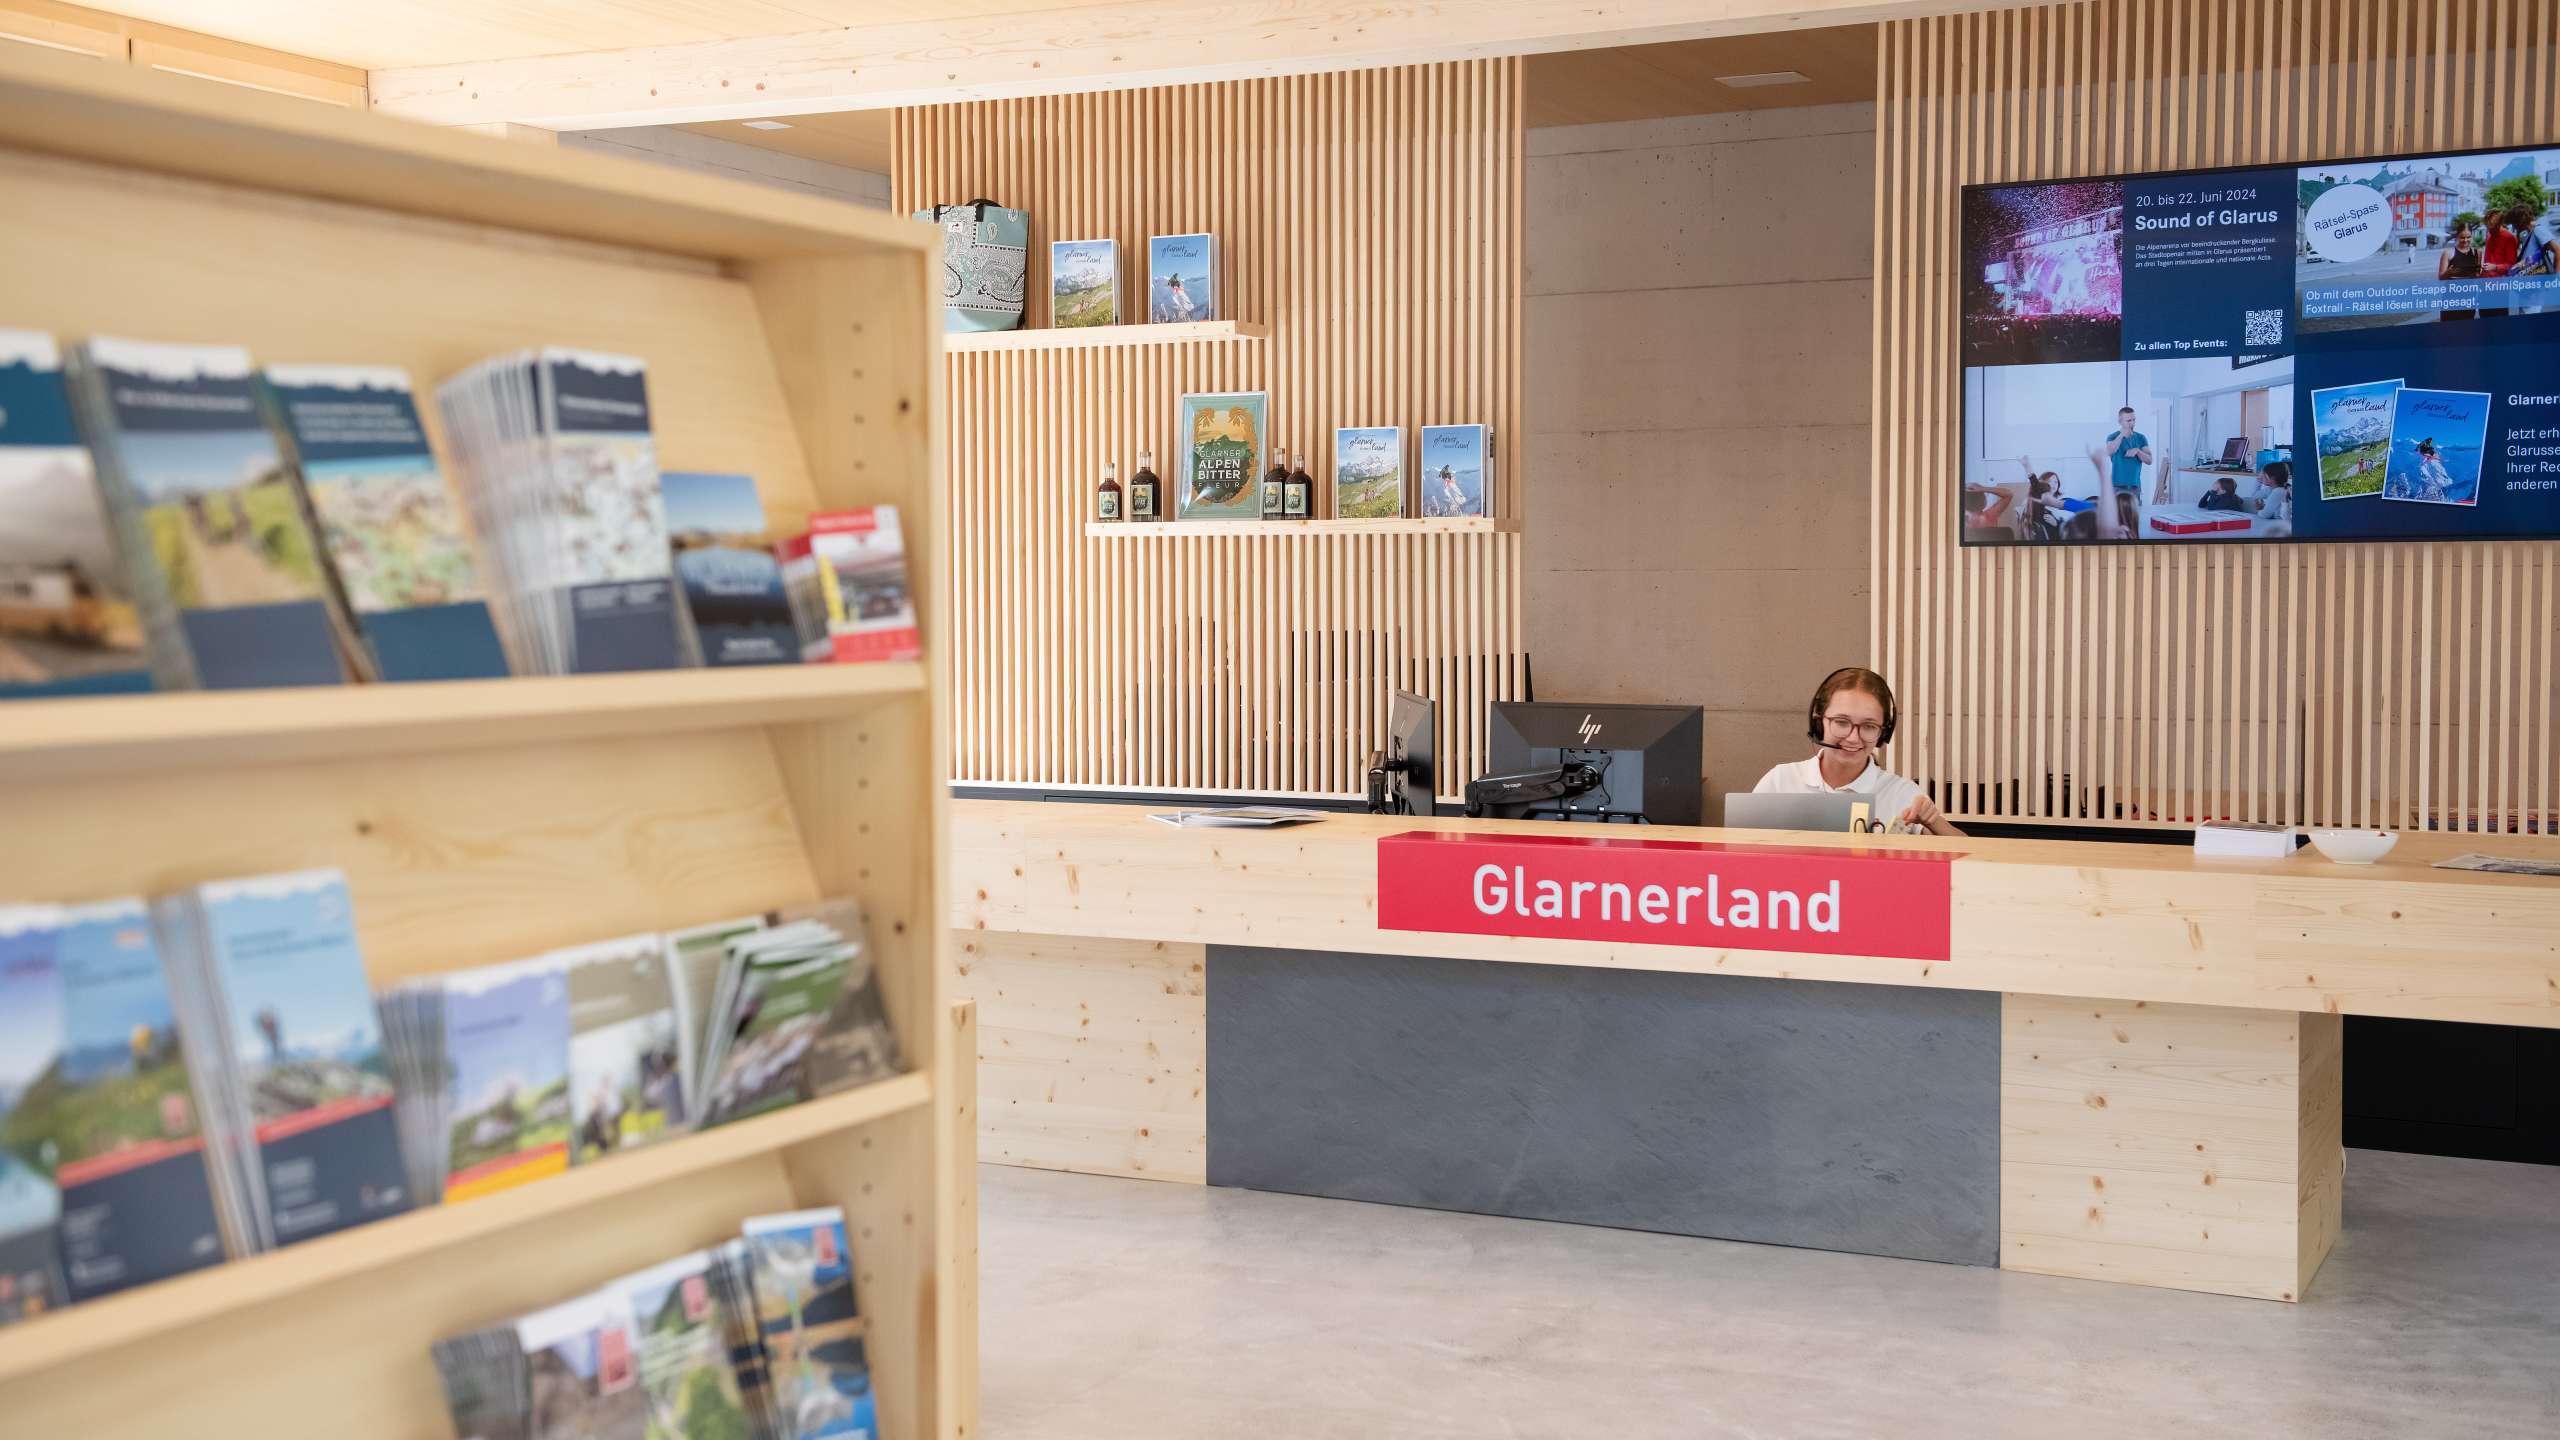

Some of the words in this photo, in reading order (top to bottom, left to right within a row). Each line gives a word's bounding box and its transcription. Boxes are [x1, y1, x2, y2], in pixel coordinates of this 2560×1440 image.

[2136, 196, 2154, 207] 20.
[2158, 194, 2175, 206] bis
[2179, 192, 2197, 204] 22.
[2200, 190, 2222, 204] Juni
[2226, 188, 2257, 201] 2024
[2135, 212, 2191, 231] Sound
[2196, 210, 2215, 227] of
[2219, 209, 2278, 225] Glarus
[2313, 203, 2380, 231] Rätsel-Spass
[2334, 222, 2368, 240] Glarus
[2306, 291, 2320, 300] Ob
[2323, 289, 2339, 299] mit
[2342, 289, 2364, 299] dem
[2366, 287, 2409, 298] Outdoor
[2411, 285, 2447, 297] Escape
[2449, 283, 2482, 294] Room,
[2544, 278, 2560, 289] od
[2306, 303, 2343, 314] Foxtrail
[2352, 302, 2384, 312] Rätsel
[2386, 300, 2413, 310] lösen
[2415, 299, 2427, 309] ist
[2430, 297, 2480, 309] angesagt.
[2134, 342, 2147, 351] Zu
[2148, 341, 2172, 350] allen
[2173, 340, 2191, 351] Top
[2192, 339, 2229, 349] Events:
[2508, 393, 2560, 406] Glarner
[2506, 428, 2536, 441] Jetzt
[1200, 449, 1241, 458] GLARNER
[1199, 459, 1241, 469] ALPEN
[2506, 461, 2537, 474] Ihrer
[1198, 469, 1241, 480] BITTER
[2506, 478, 2557, 491] anderen
[1473, 863, 1842, 934] Glarnerland
